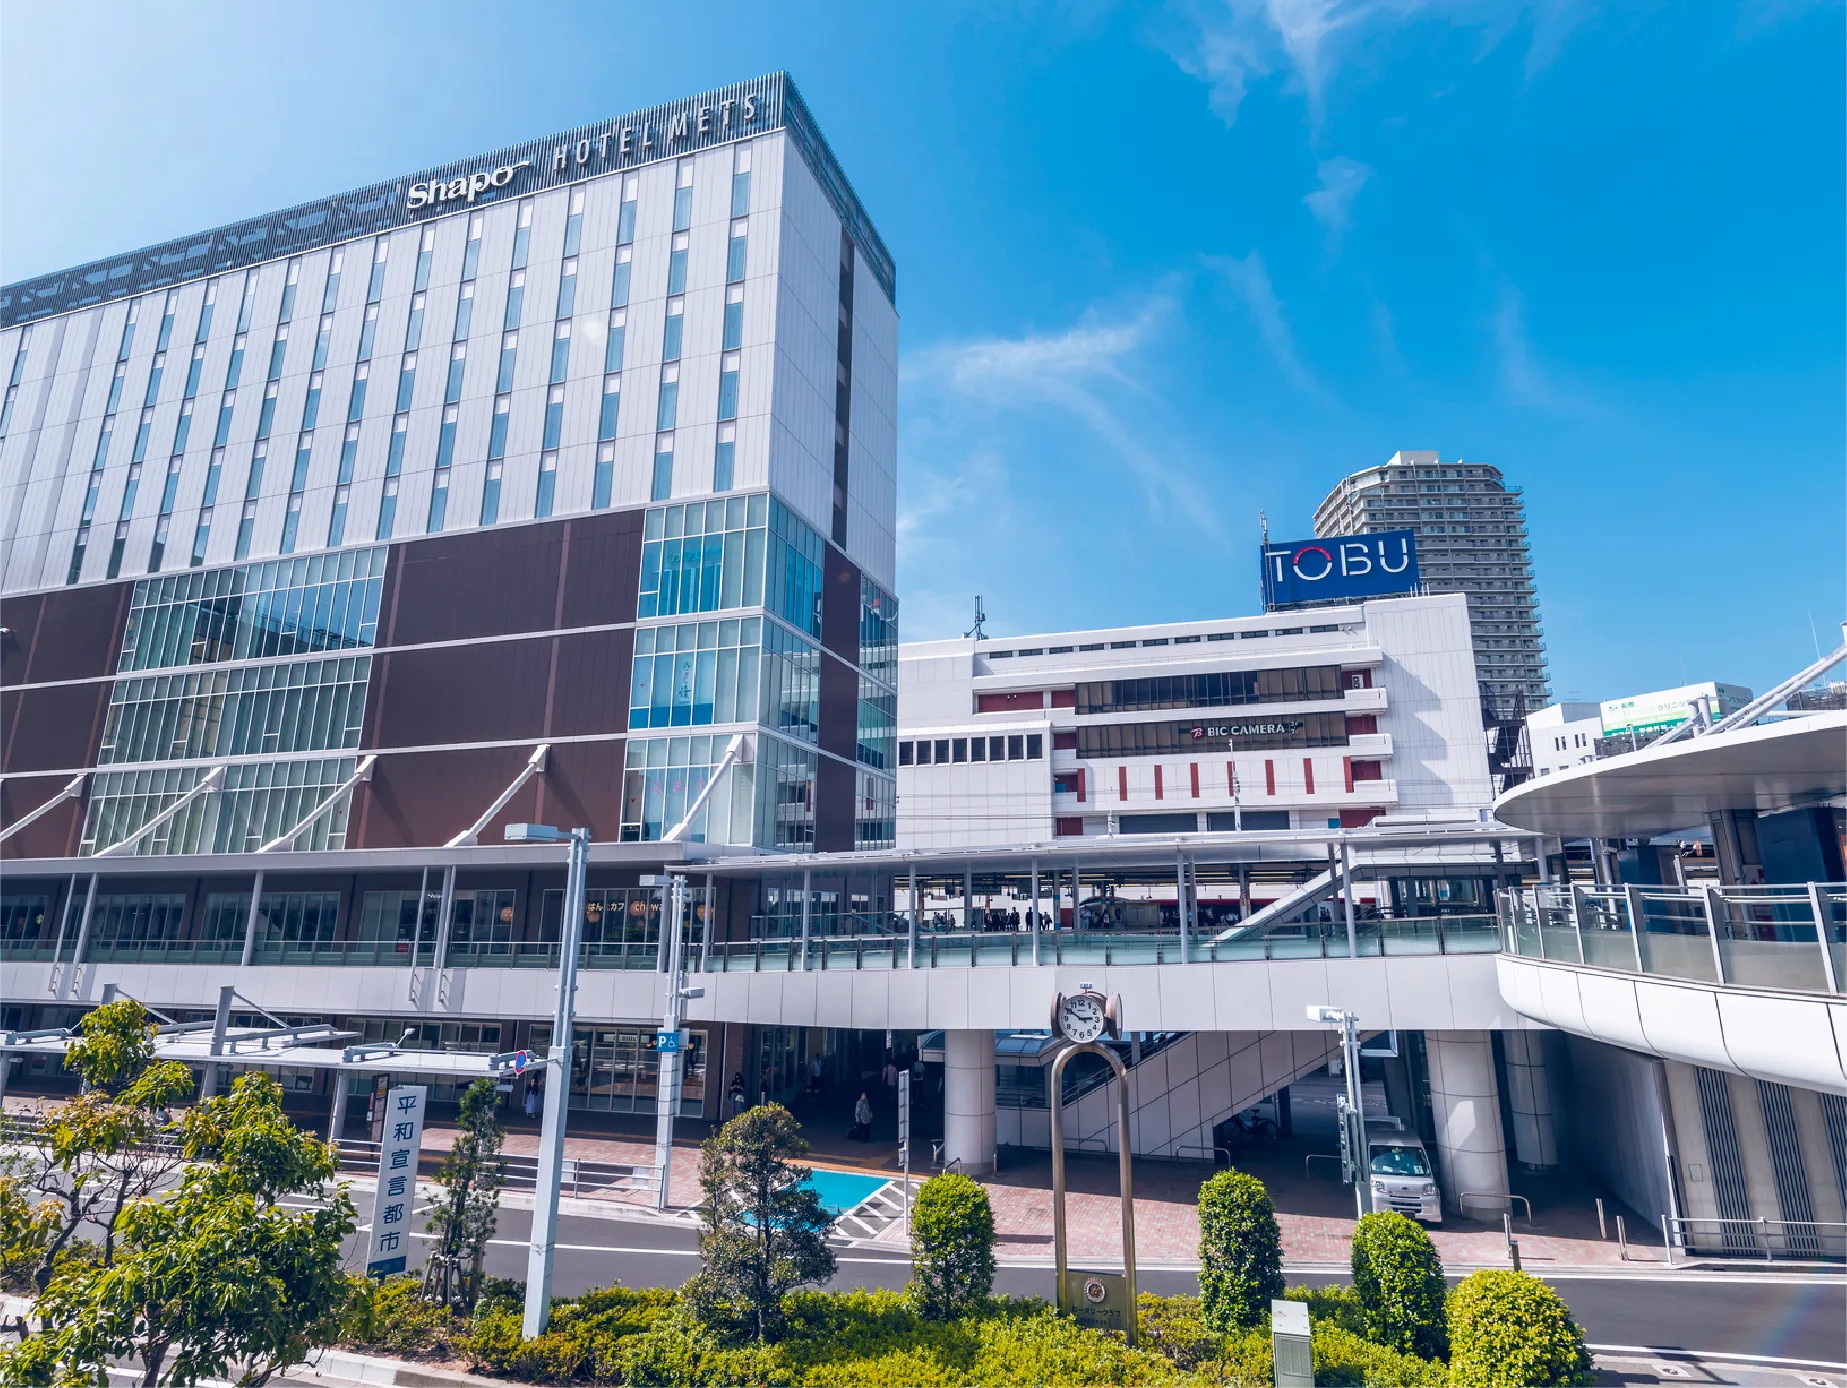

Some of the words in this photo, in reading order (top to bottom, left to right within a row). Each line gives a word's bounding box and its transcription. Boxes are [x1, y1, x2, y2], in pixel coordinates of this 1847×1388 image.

[553, 125, 653, 172] HOTEL
[669, 94, 756, 141] METS
[406, 160, 531, 209] Shapo
[1265, 538, 1410, 582] TOBU
[1207, 726, 1228, 737] BIC
[1230, 723, 1285, 736] CAMERA
[658, 1035, 667, 1047] P
[380, 1095, 417, 1252] 平和宣言都市
